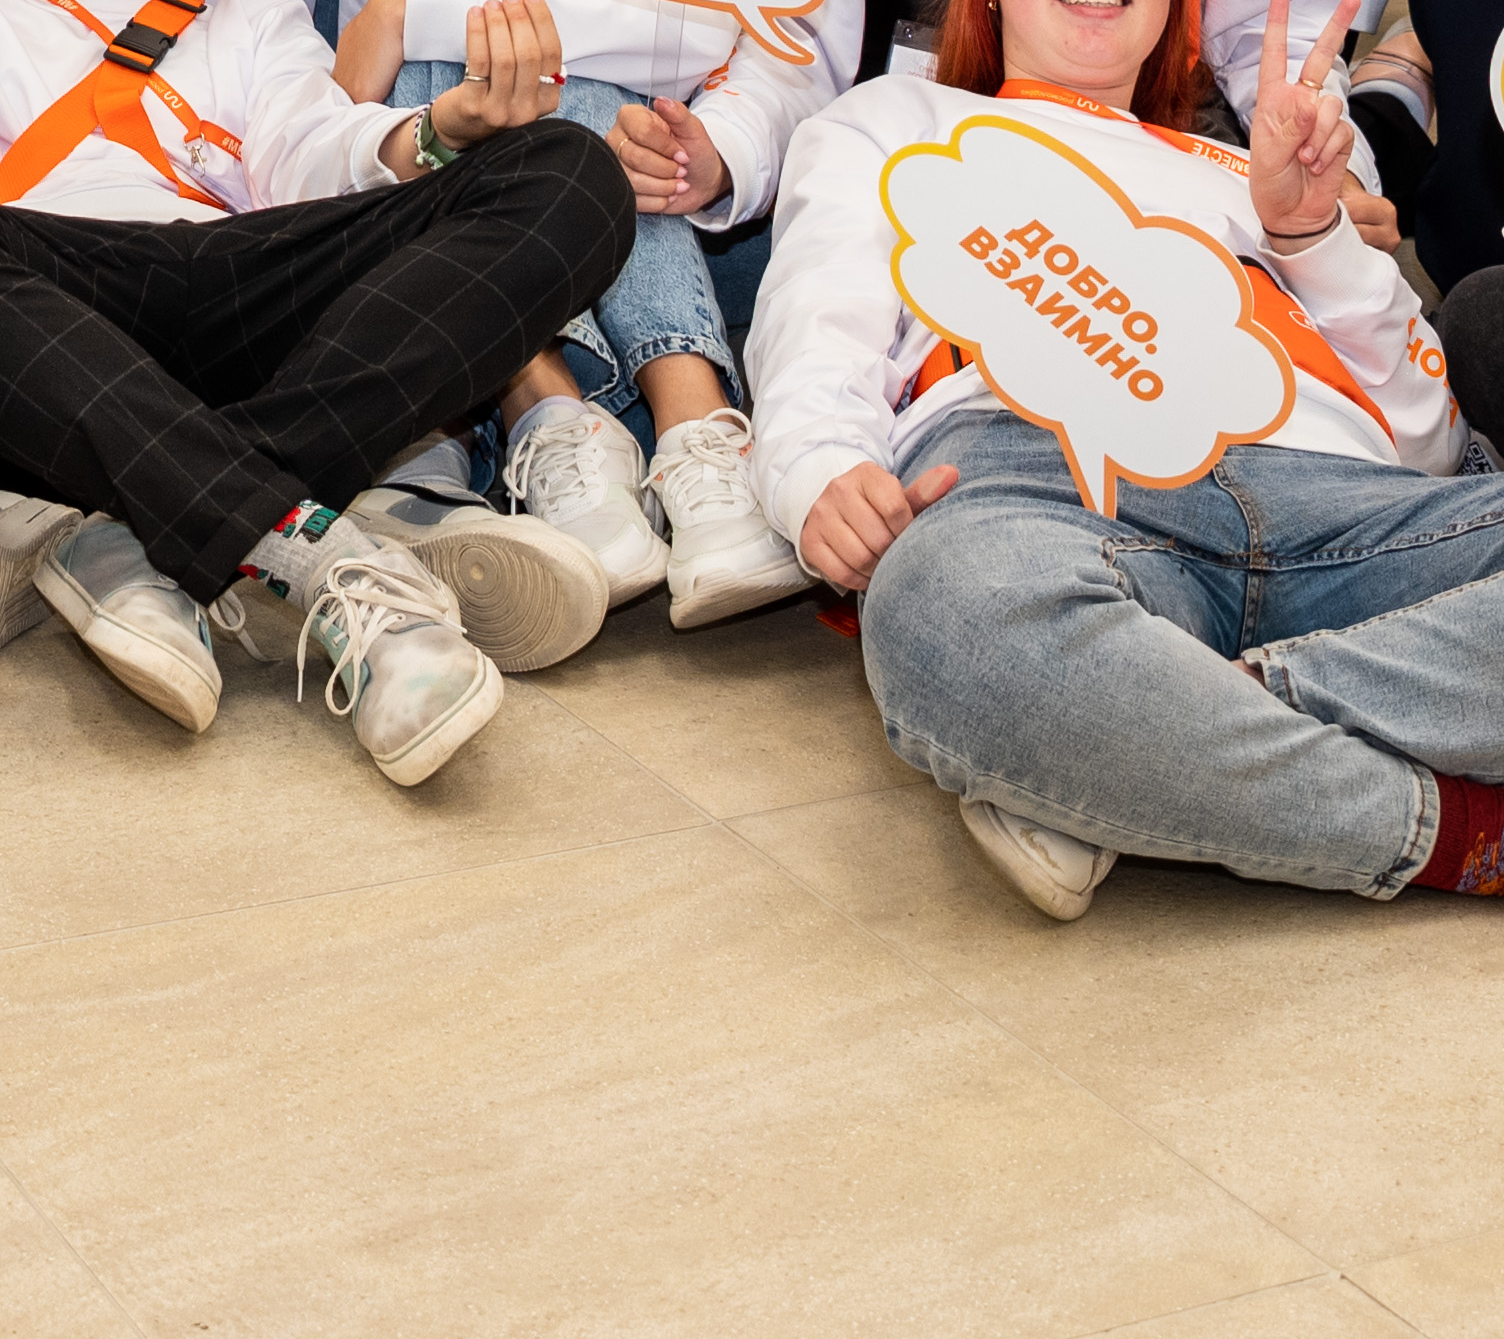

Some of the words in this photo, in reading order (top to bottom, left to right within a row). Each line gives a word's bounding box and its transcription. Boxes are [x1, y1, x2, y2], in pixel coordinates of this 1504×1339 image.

[1191, 142, 1251, 177] ВМЕСТЕ
[958, 224, 1165, 405] ВЗАИМНО
[1000, 217, 1162, 354] ДОБРО.
